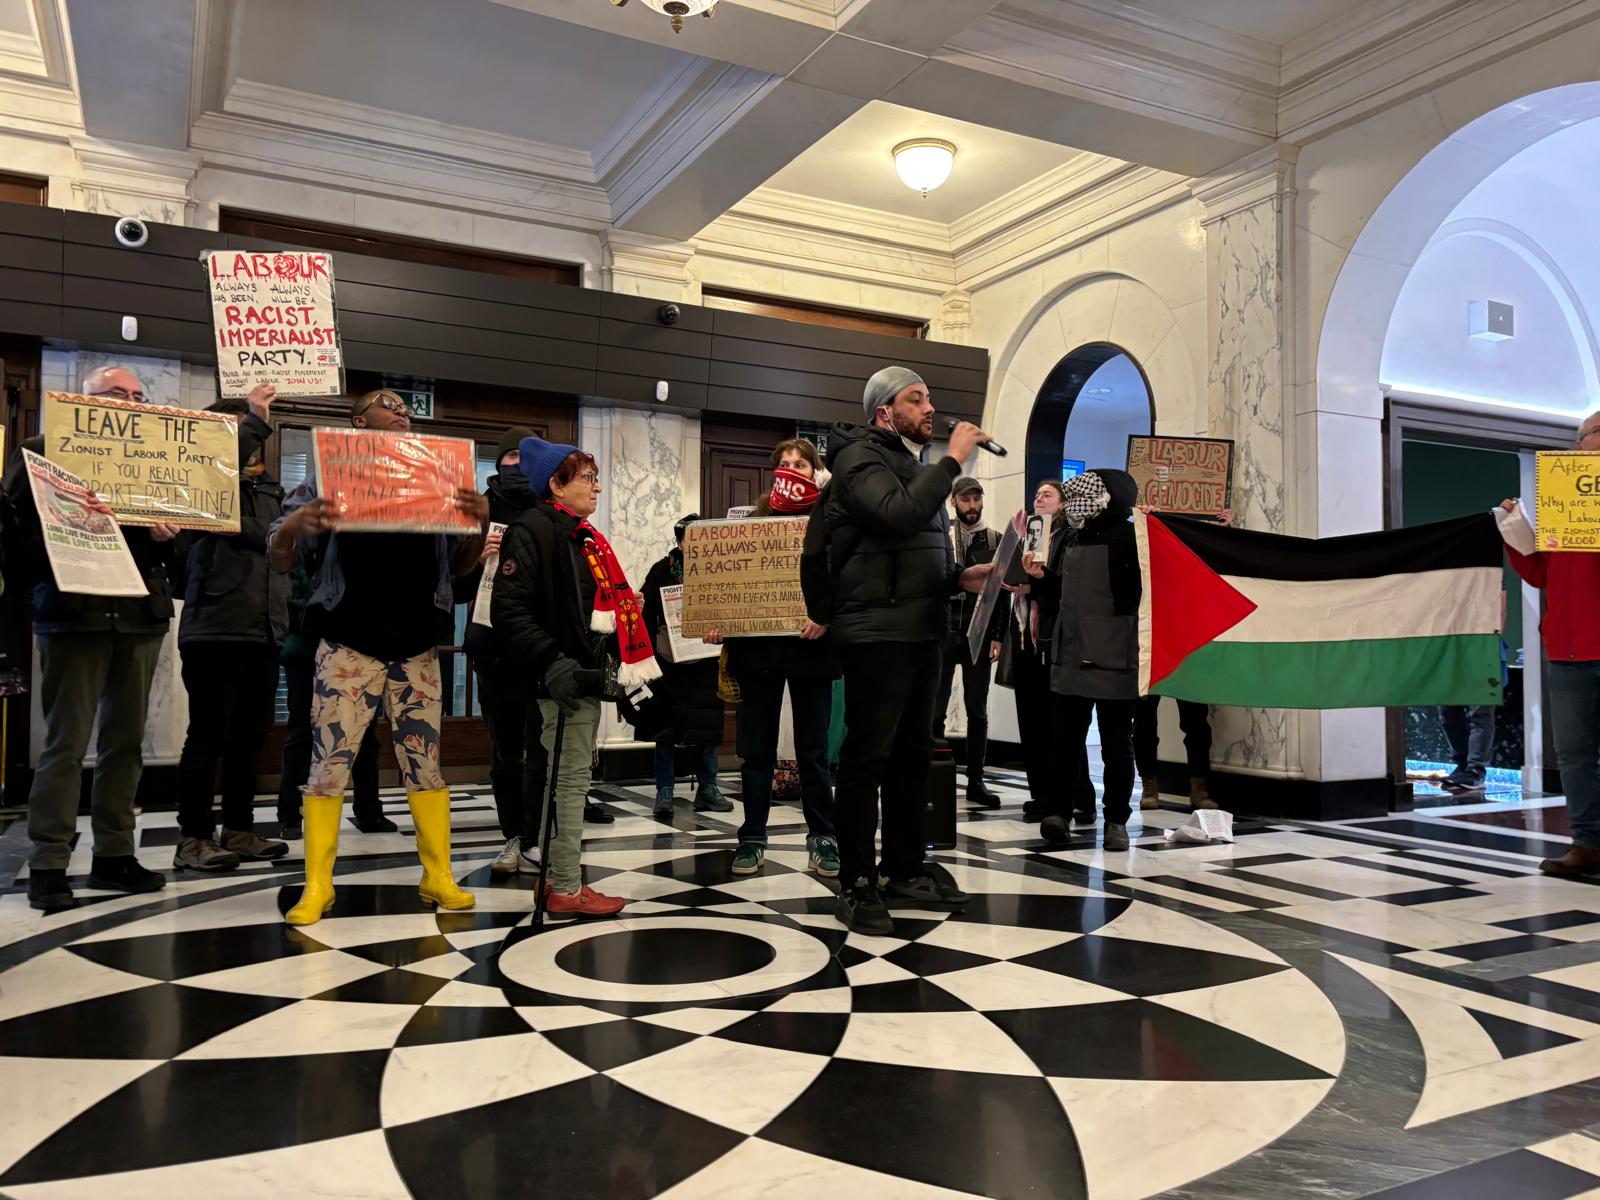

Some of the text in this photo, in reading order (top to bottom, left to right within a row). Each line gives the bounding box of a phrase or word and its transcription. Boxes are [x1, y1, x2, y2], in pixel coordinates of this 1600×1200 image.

[212, 253, 330, 280] LABOUR
[215, 283, 311, 296] ALWAYS ALWAYS
[271, 296, 291, 304] WILL
[219, 328, 334, 347] IMPERIALIST
[238, 349, 311, 367] PARTY.
[285, 377, 305, 385] JOIN
[308, 377, 322, 385] US!
[74, 408, 200, 444] LEAVE THE
[27, 453, 52, 472] FIGHT
[1150, 440, 1226, 472] LABOUR
[92, 462, 192, 482] IF YOU REALLY
[1550, 458, 1592, 476] After
[1576, 475, 1600, 494] GE
[145, 485, 235, 513] PALESTINE!
[1145, 480, 1224, 511] GENOCIDE
[1540, 496, 1564, 513] Why
[46, 523, 118, 542] LONG LIVE PALESTINE
[690, 525, 747, 541] LABOUR
[752, 521, 788, 537] PARTY
[1562, 536, 1596, 545] BLOOD
[48, 532, 121, 551] LONG LIVE GAZA
[688, 546, 698, 559] IS
[762, 540, 789, 551] WILL
[688, 555, 800, 577] A RACIST PARTY
[716, 582, 737, 592] YEAR
[743, 582, 760, 590] WE
[698, 593, 740, 605] PERSON
[743, 592, 769, 603] EVERY
[769, 591, 777, 602] 8
[730, 621, 747, 632] PHIL
